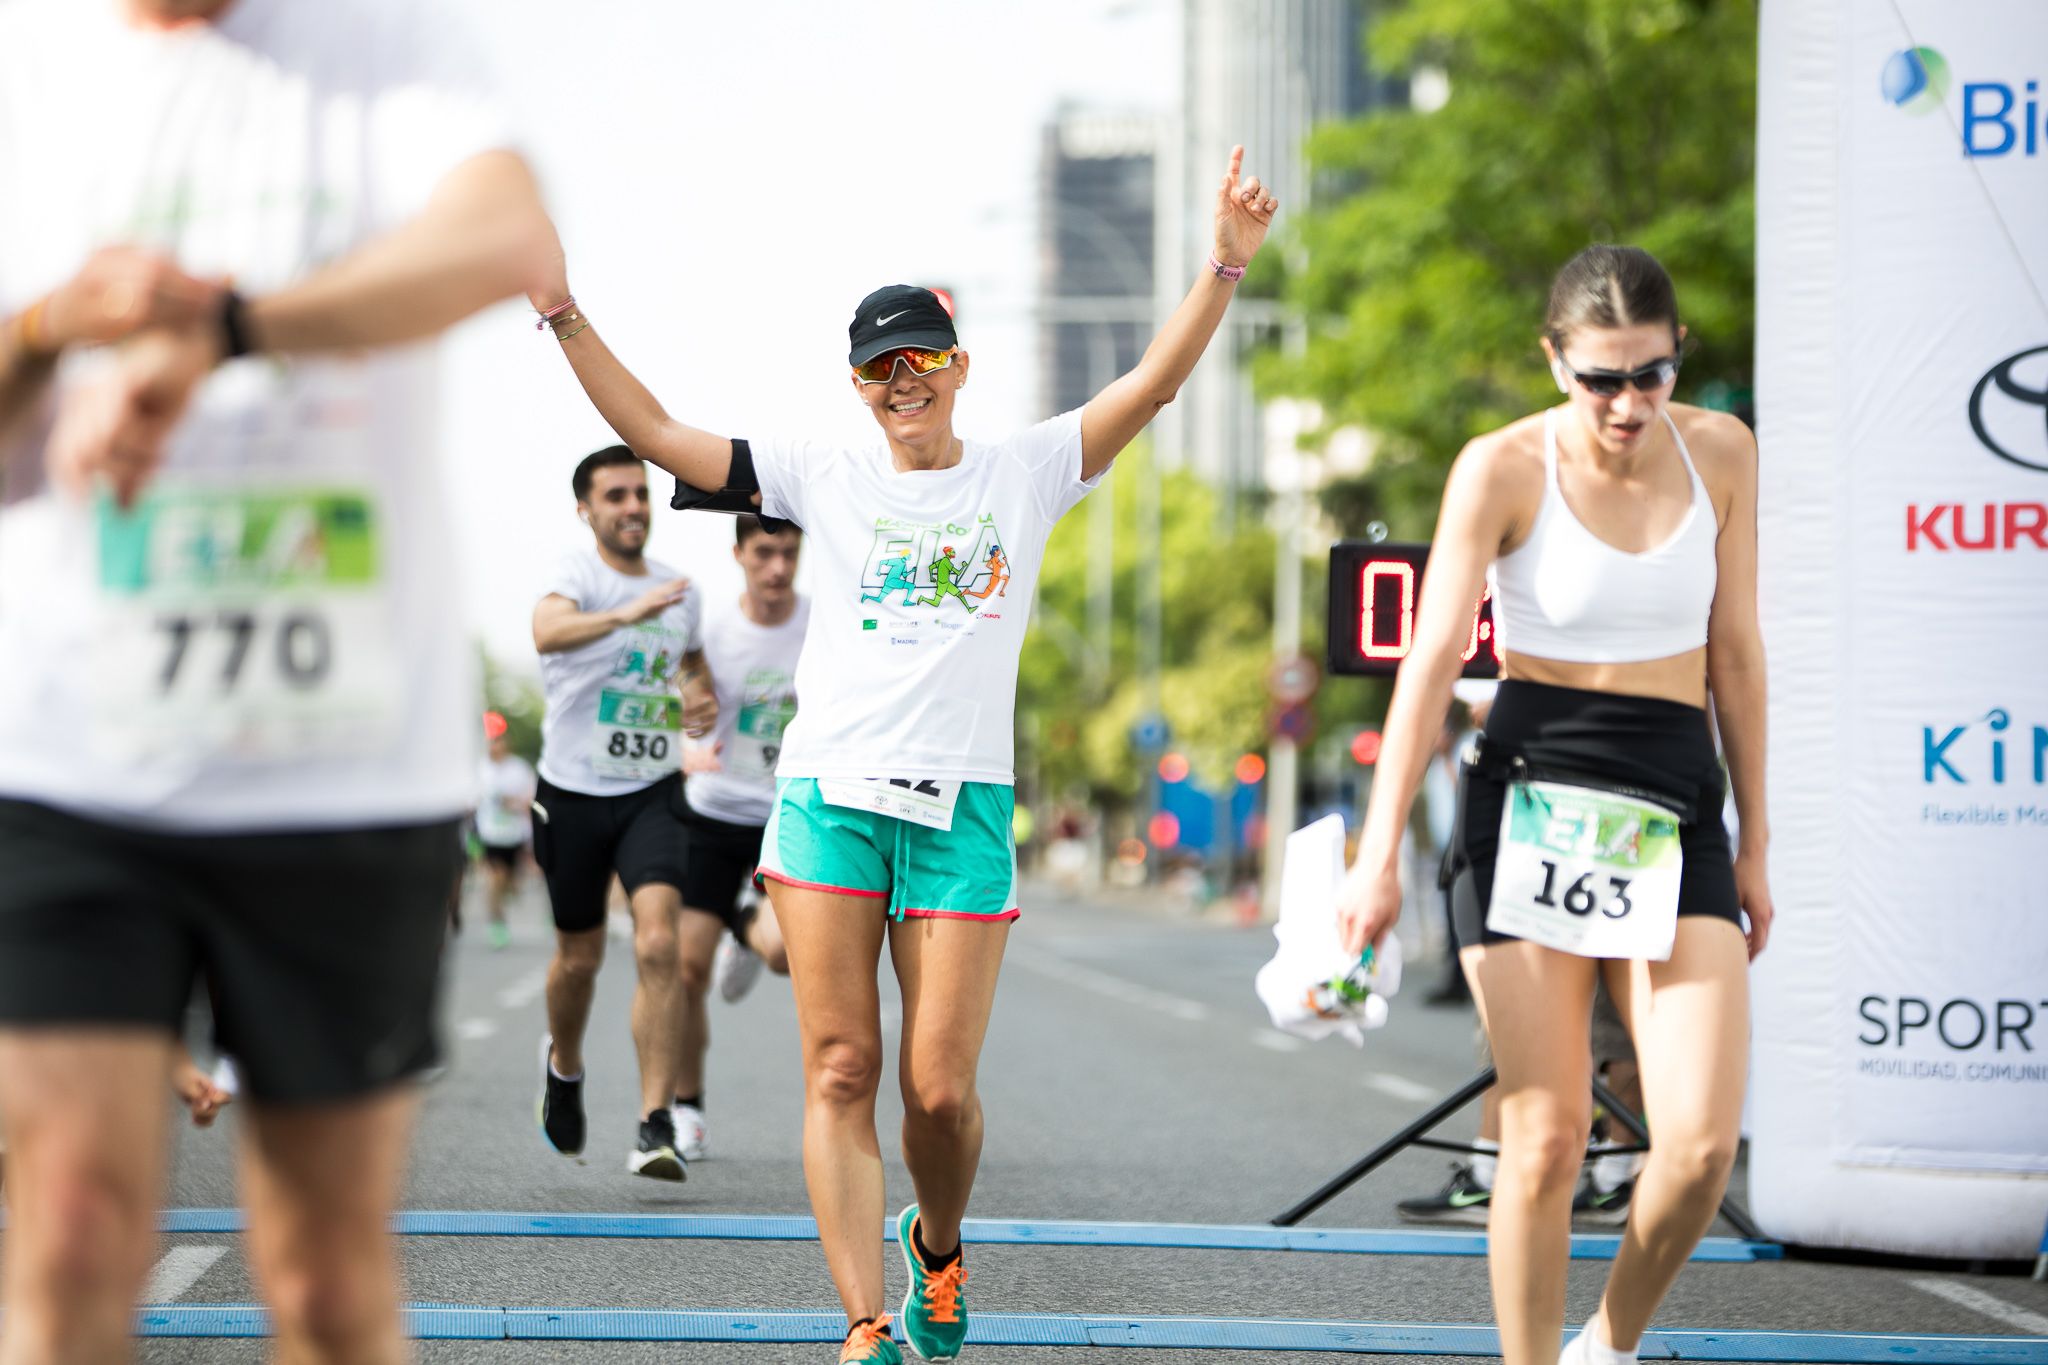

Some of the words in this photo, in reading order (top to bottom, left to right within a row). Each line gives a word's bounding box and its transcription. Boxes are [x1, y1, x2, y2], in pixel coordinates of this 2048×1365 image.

[1963, 82, 2048, 158] Bi
[978, 513, 993, 524] LA
[154, 613, 332, 696] 770
[608, 731, 668, 760] 830
[1923, 804, 2009, 825] Flexible
[1534, 860, 1632, 918] 163
[1859, 996, 2048, 1051] SPOR
